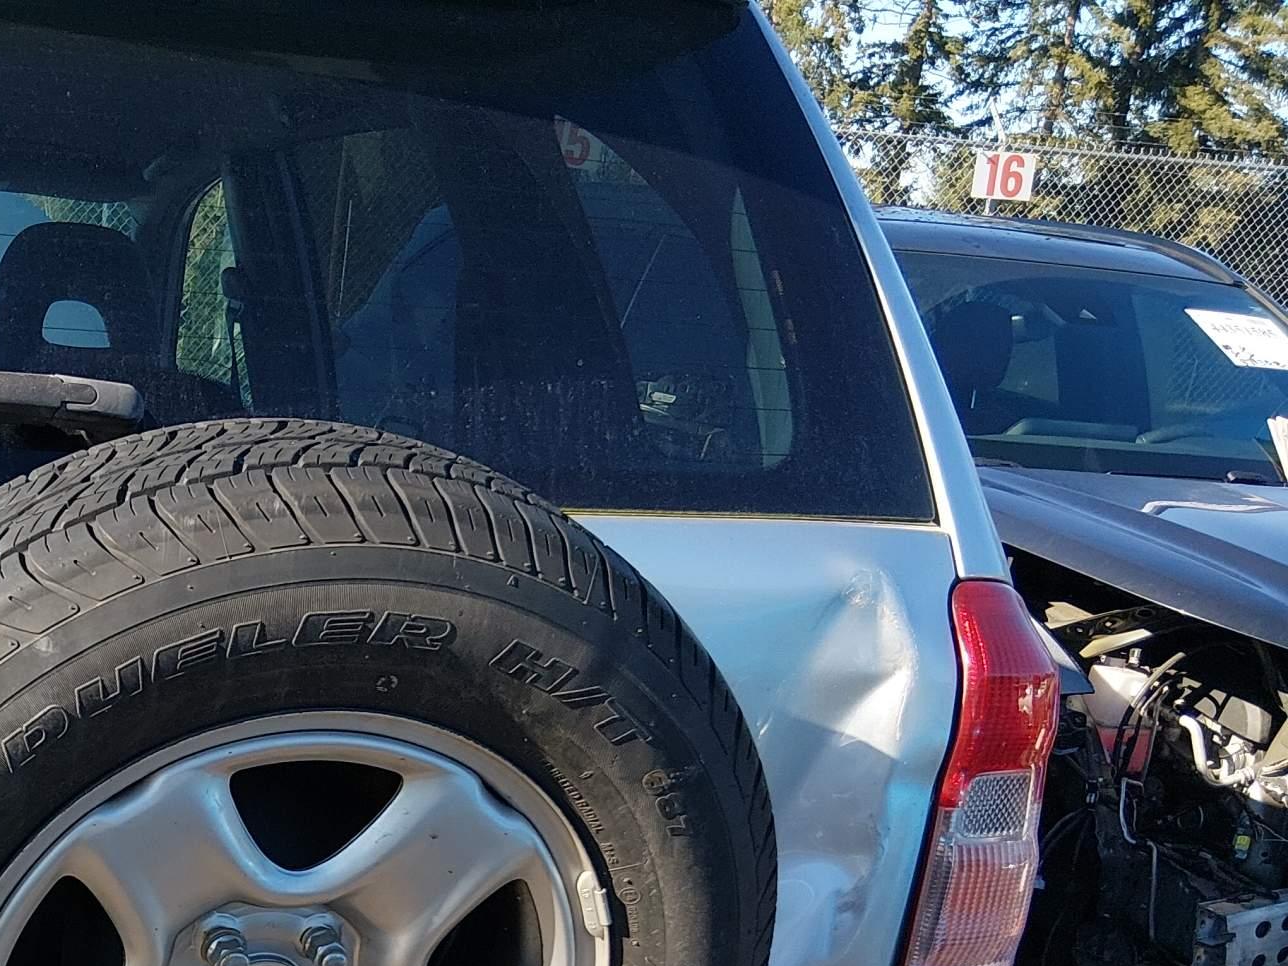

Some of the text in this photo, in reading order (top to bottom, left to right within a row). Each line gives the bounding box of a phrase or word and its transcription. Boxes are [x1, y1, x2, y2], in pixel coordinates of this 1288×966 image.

[986, 154, 1025, 198] 16
[2, 610, 457, 773] DUELER
[489, 639, 653, 747] H/T
